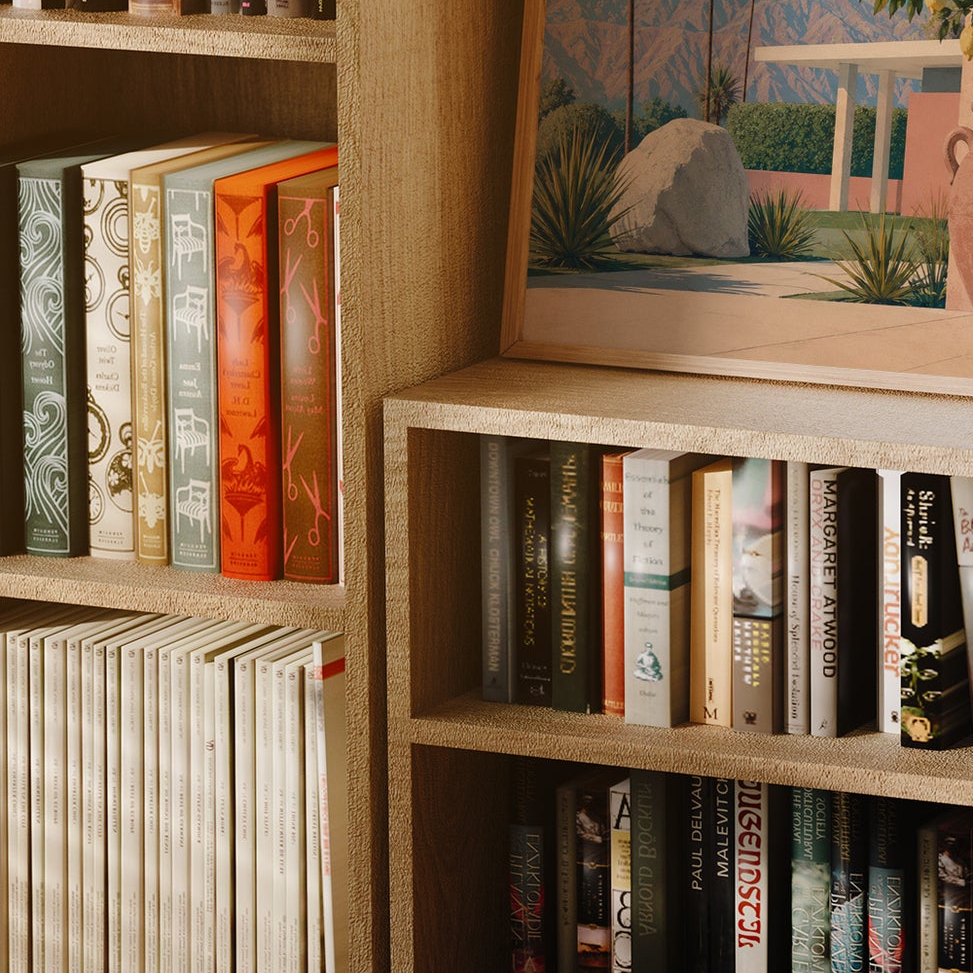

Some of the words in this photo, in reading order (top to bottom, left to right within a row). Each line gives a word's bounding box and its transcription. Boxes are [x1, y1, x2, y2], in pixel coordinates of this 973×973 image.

[811, 479, 823, 530] ORYX
[823, 479, 837, 589] MARGARET
[811, 585, 823, 651] CRAKE
[823, 595, 837, 678] ATWOOD
[691, 777, 703, 843] DELVAU
[691, 848, 703, 891] PAUL
